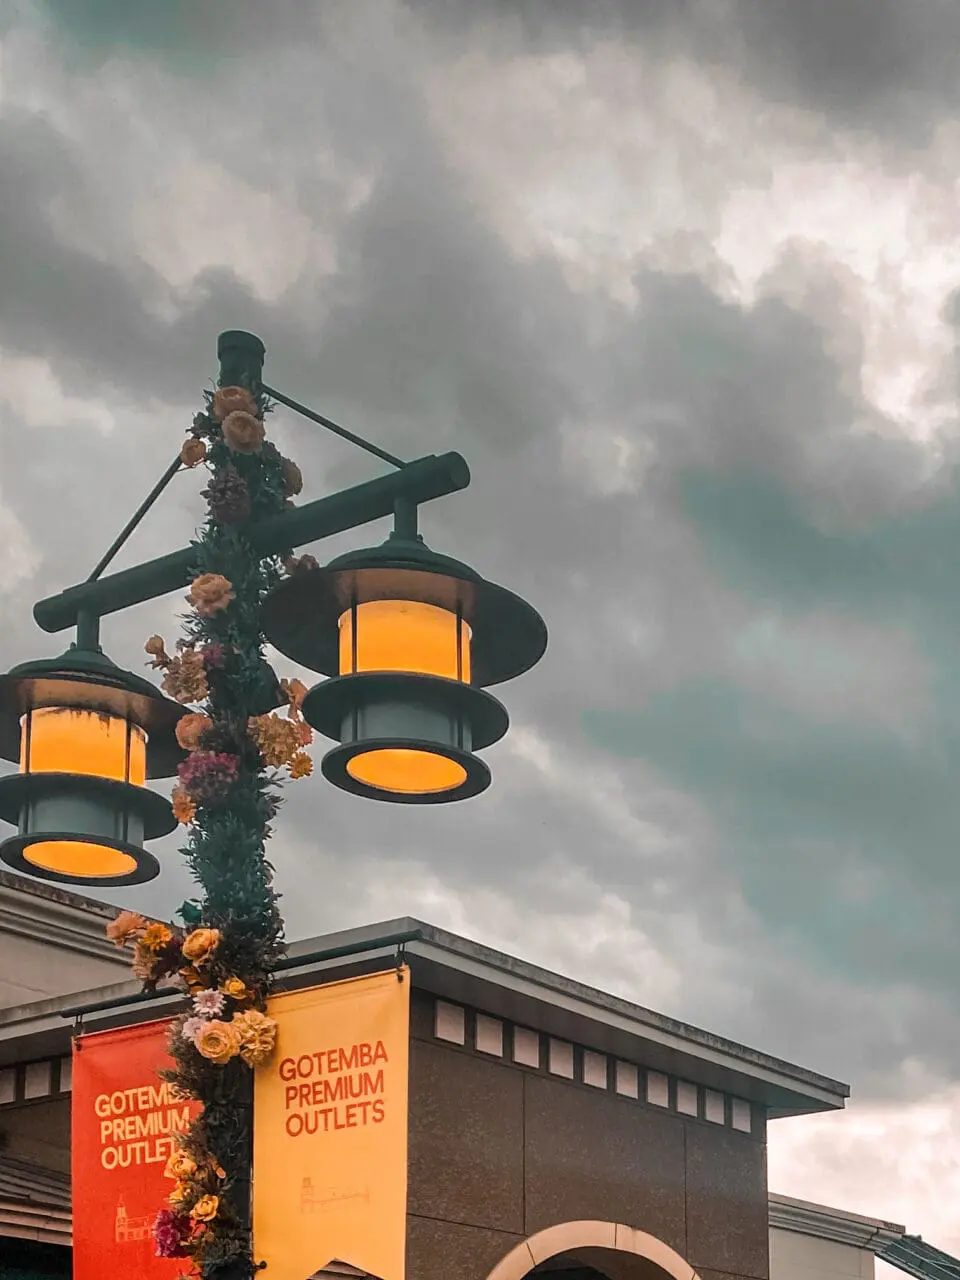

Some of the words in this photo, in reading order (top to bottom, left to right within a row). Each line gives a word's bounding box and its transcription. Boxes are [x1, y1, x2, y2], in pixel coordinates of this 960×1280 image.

[279, 1040, 388, 1082] GOTEMBA
[94, 1082, 185, 1118] GOTEM
[285, 1070, 385, 1110] PREMIUM
[100, 1106, 190, 1144] PREMIUM
[285, 1099, 386, 1138] OUTLETS
[101, 1137, 176, 1170] OUTLET
